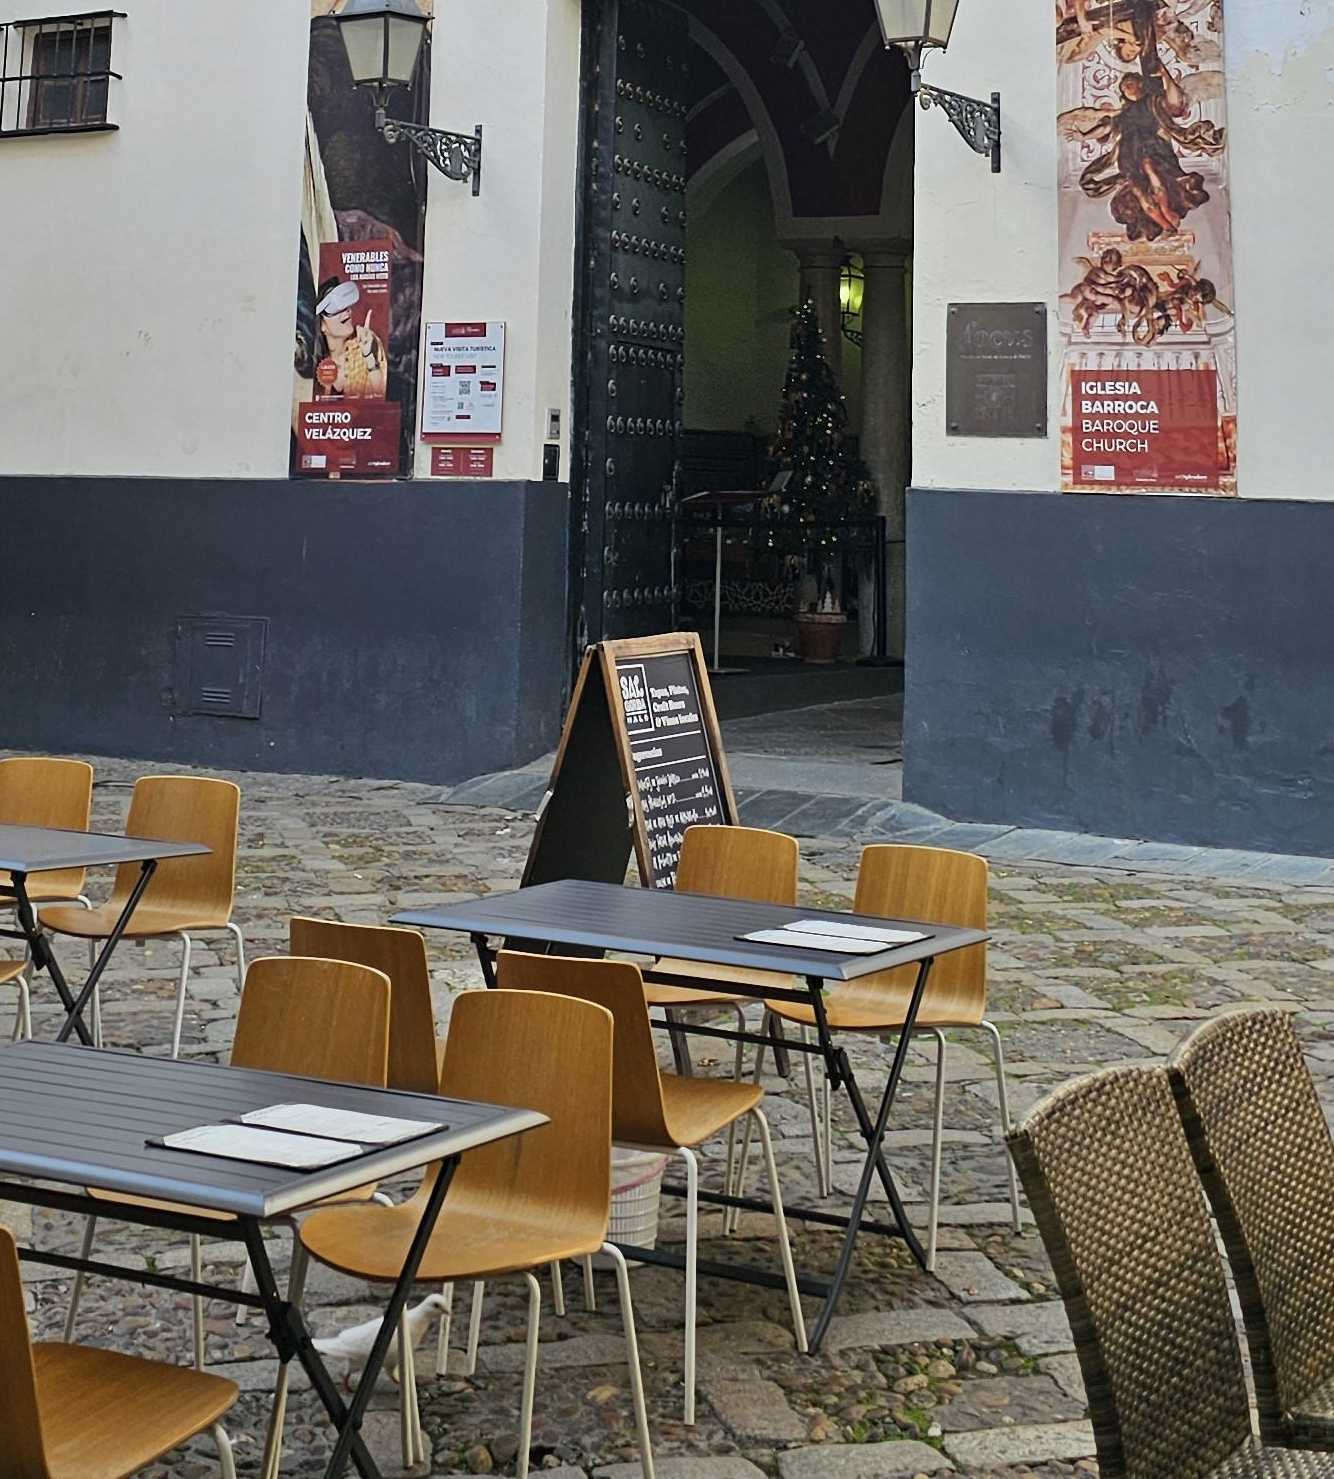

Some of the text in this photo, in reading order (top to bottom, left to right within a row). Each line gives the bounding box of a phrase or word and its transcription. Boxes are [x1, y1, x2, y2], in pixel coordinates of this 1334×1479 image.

[341, 251, 389, 264] VENERABLES
[1081, 381, 1142, 395] IGLESIA
[1081, 400, 1159, 414] BARROCA
[304, 412, 351, 424] CENTRO
[304, 425, 372, 441] VELÁZQUEZ
[1082, 419, 1160, 435] BAROQUE
[1081, 438, 1149, 453] CHURCH
[619, 674, 645, 700] SAL
